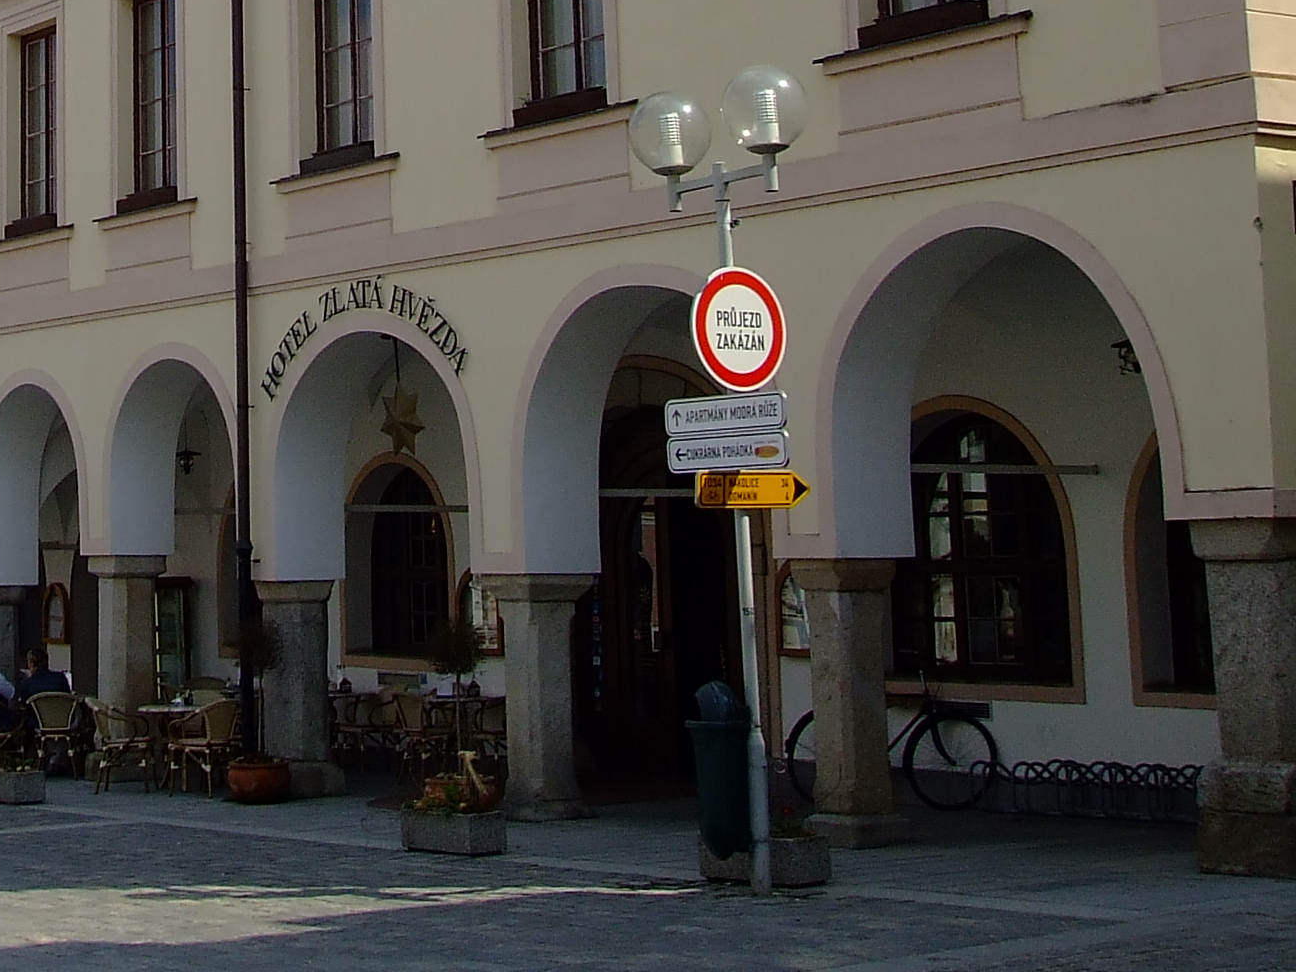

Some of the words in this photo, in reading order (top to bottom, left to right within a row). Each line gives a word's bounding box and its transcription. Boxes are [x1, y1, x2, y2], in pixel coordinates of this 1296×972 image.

[716, 306, 762, 329] PRŮJEZD
[260, 311, 317, 402] HOTEL
[318, 275, 385, 323] ZLATÁ
[389, 285, 468, 377] HVĚZDA
[716, 329, 765, 351] ZAKÁZÁN
[685, 405, 728, 425] APARTMÁNY
[729, 401, 757, 421] MODRÁ
[758, 400, 778, 418] RŮŽE
[686, 444, 721, 461] CUKRÁRNA
[722, 442, 753, 458] POHÁDKA
